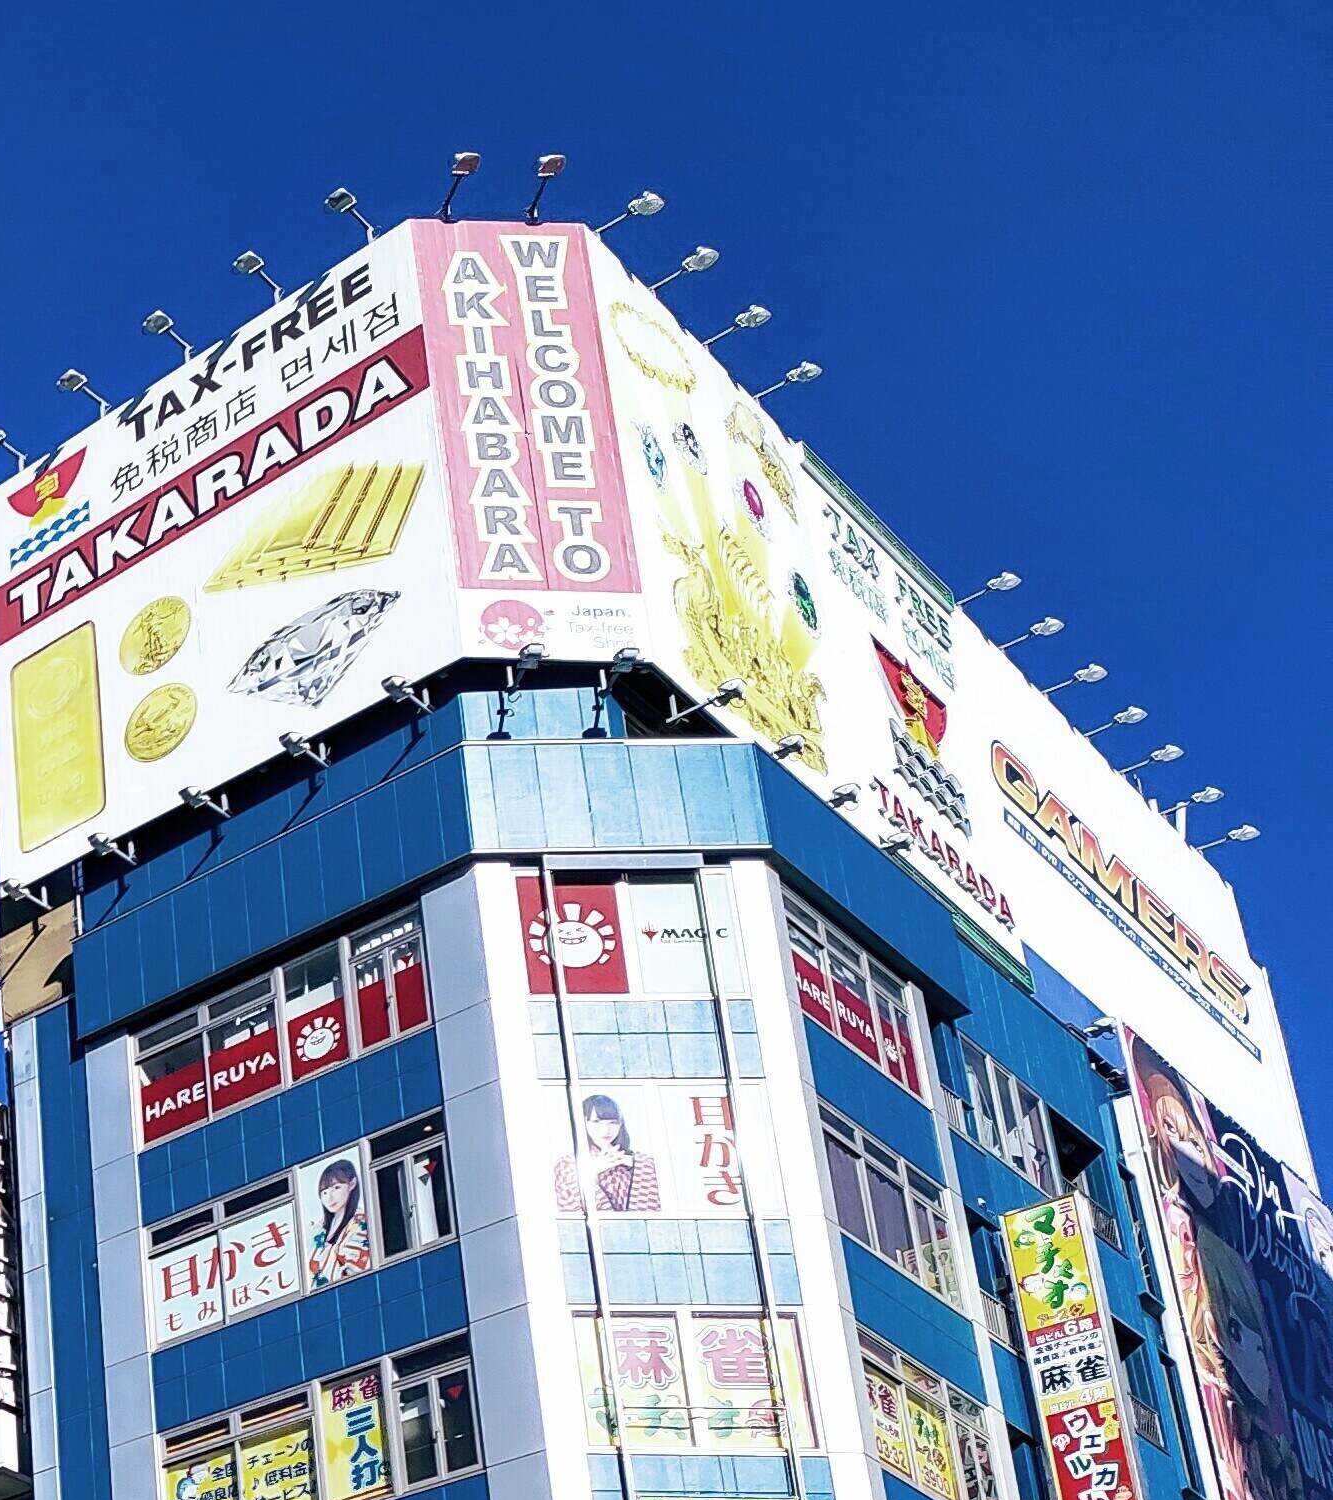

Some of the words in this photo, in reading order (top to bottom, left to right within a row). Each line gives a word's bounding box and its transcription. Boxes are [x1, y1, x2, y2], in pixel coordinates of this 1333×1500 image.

[111, 386, 257, 500] 免税商店
[281, 292, 401, 394] 면세점
[122, 264, 374, 442] TAX-FREE
[452, 250, 532, 576] AKIHABARA
[511, 239, 589, 484] WELCOME
[558, 505, 603, 578] TO
[7, 359, 413, 625] TAKARADA
[823, 504, 877, 578] TAX
[895, 570, 952, 651] FREE
[872, 777, 1015, 933] TAKARADA
[991, 740, 1251, 1024] GAMERS
[164, 1271, 296, 1332] もみほぐし
[613, 1326, 774, 1390] 麻雀
[1039, 1356, 1109, 1396] 麻雀
[331, 1375, 382, 1412] 麻雀
[345, 1405, 380, 1491] 三人打
